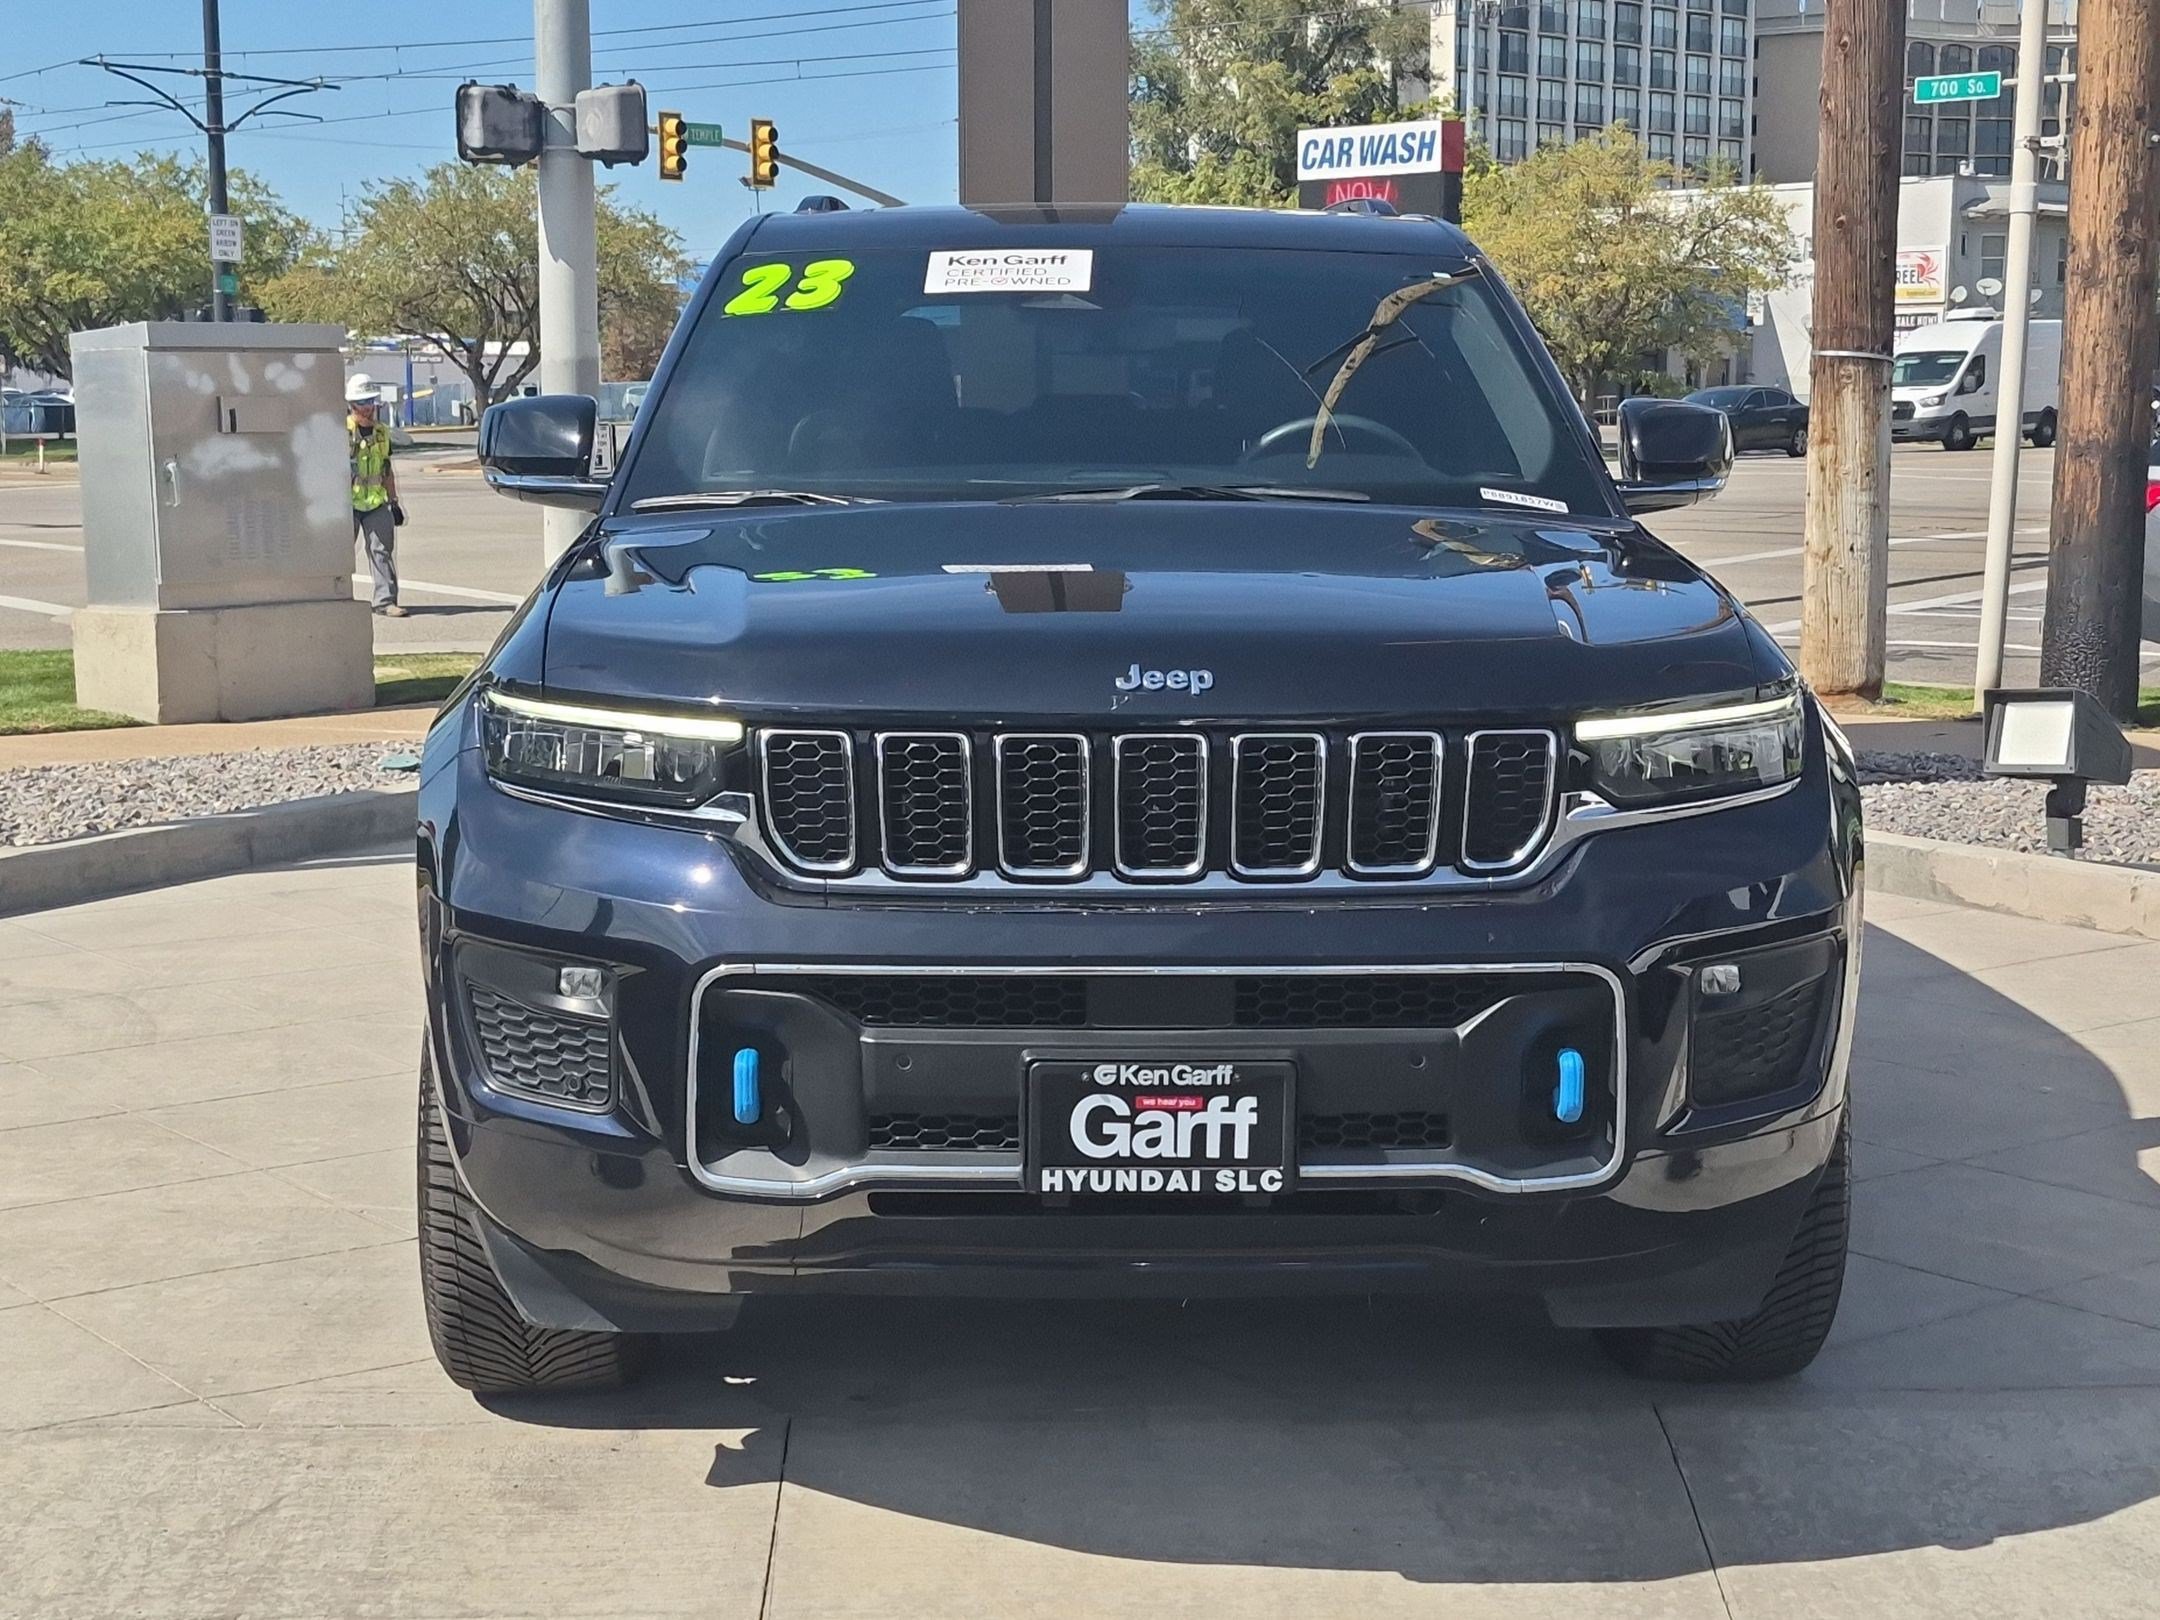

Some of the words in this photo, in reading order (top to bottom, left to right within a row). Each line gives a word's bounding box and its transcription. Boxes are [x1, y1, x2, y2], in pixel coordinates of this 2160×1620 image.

[1930, 80, 1958, 97] 700
[1967, 78, 1987, 94] So.
[1302, 137, 1354, 170] CAR
[1360, 130, 1437, 167] WASH
[1335, 180, 1390, 201] NOW
[948, 256, 998, 267] Ken
[1003, 255, 1068, 266] Garff
[946, 267, 1048, 278] CERTIFIED
[723, 258, 856, 317] 23
[1115, 663, 1214, 695] Jeep
[1120, 1064, 1170, 1086] Ken
[1171, 1064, 1234, 1086] Garff
[1178, 1099, 1196, 1108] you
[1069, 1093, 1259, 1160] Garff
[1041, 1169, 1202, 1193] HYUNDAI
[1214, 1169, 1284, 1193] SLC
